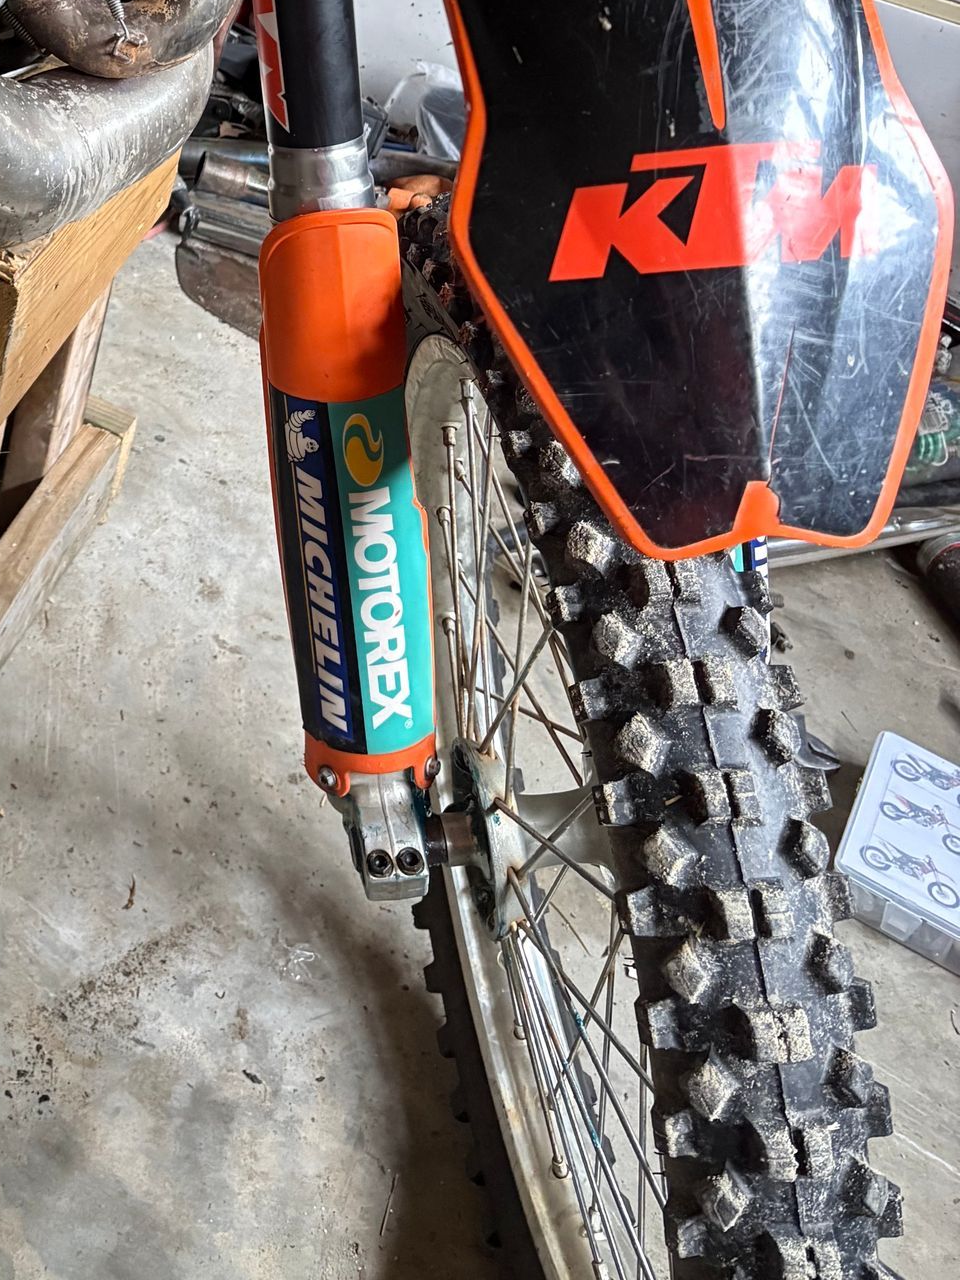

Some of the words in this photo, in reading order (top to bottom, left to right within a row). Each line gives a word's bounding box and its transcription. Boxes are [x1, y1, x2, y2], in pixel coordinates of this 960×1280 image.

[548, 140, 878, 282] KTM
[296, 465, 349, 733] MICHELIN
[347, 485, 413, 730] MOTOREX
